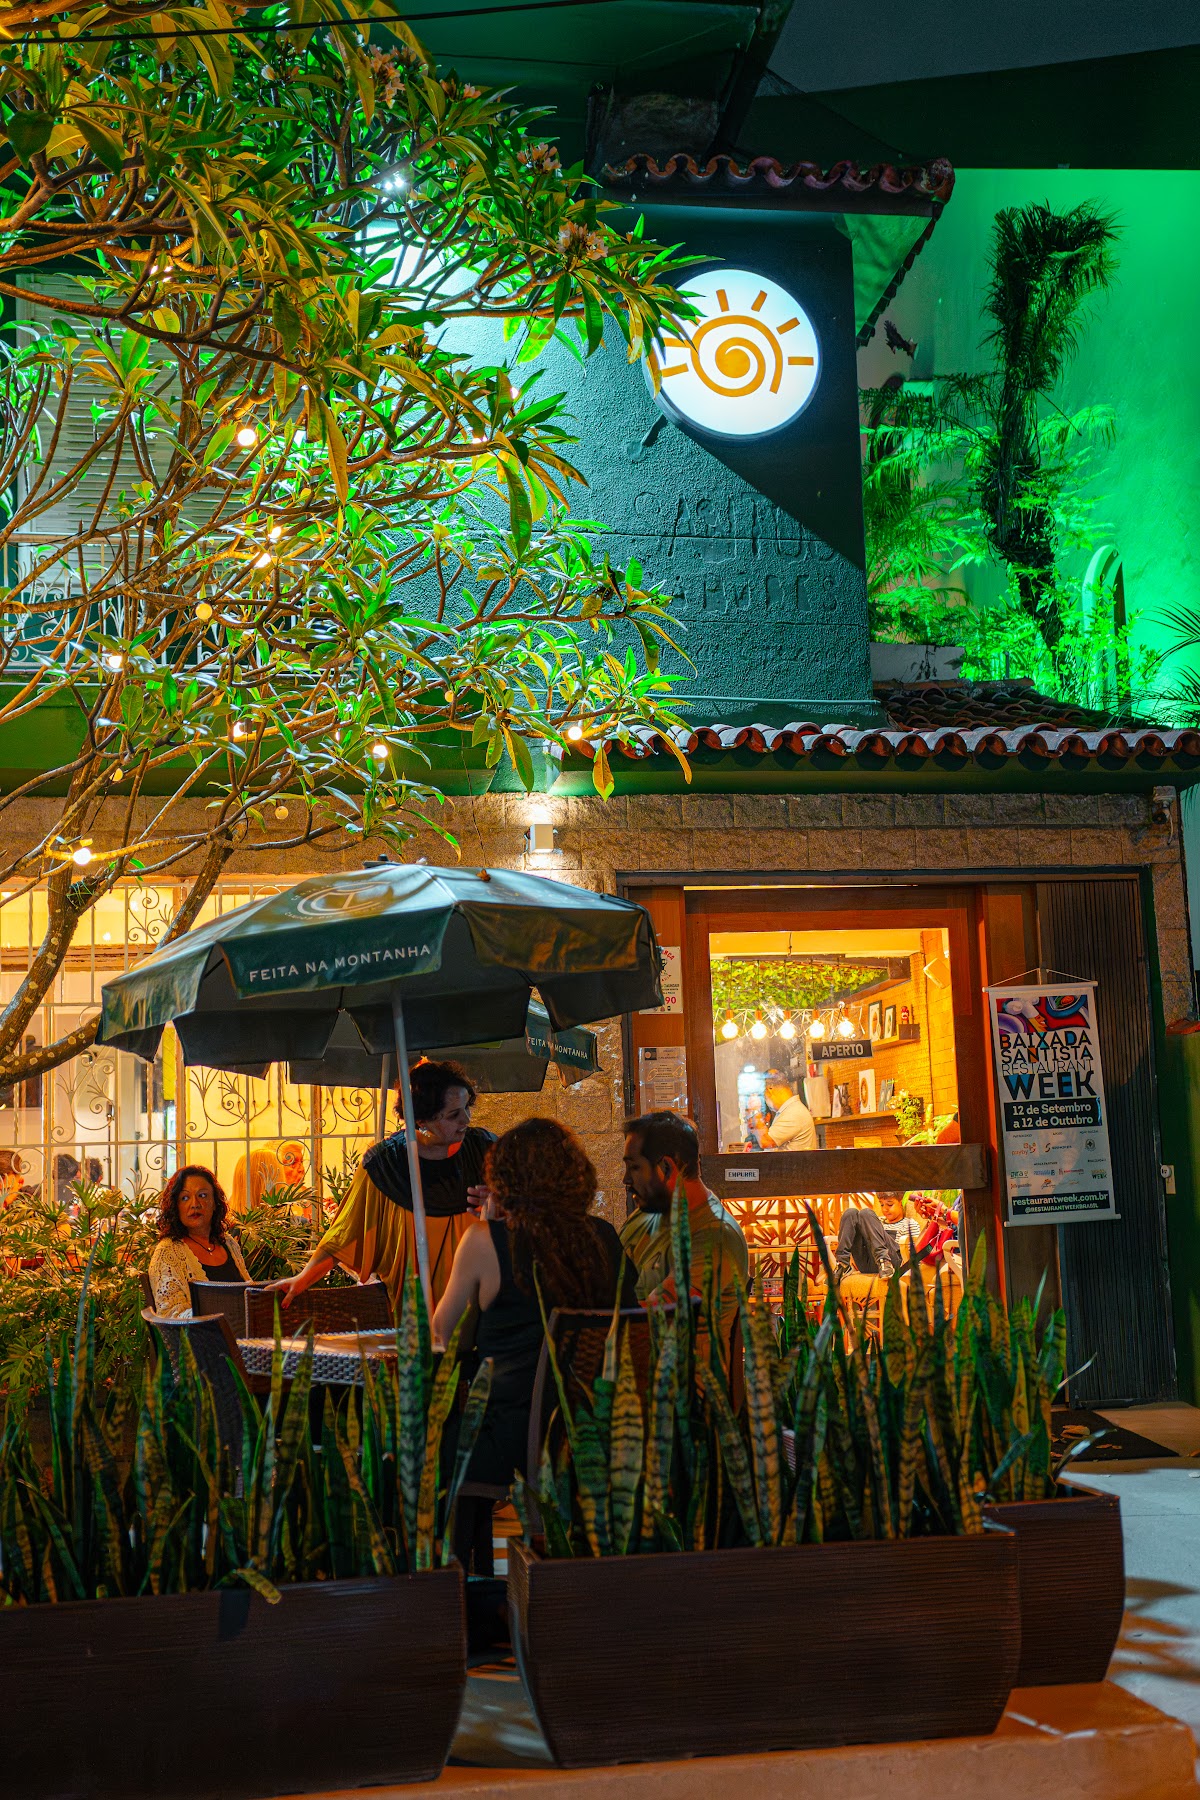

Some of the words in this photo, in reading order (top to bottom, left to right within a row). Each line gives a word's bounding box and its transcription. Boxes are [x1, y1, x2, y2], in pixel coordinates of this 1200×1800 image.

[249, 964, 299, 983] FEITA
[305, 960, 329, 974] NA
[334, 944, 431, 968] MONTANHA
[527, 1036, 546, 1048] FEITA
[554, 1044, 588, 1060] MONTANHA
[1000, 1030, 1092, 1049] BAIXADA
[821, 1043, 864, 1058] APERTO
[1001, 1045, 1094, 1064] SANTISTA
[1001, 1060, 1092, 1076] RESTAURANT
[1003, 1070, 1097, 1100] WEEK
[1012, 1106, 1025, 1116] 12
[1026, 1105, 1039, 1115] de
[1041, 1102, 1092, 1114] Setembro
[1013, 1120, 1020, 1129] a
[1021, 1117, 1034, 1128] 12
[1035, 1117, 1048, 1127] de
[1050, 1115, 1094, 1126] Outubro
[1012, 1192, 1108, 1206] restaurantweek.com.br
